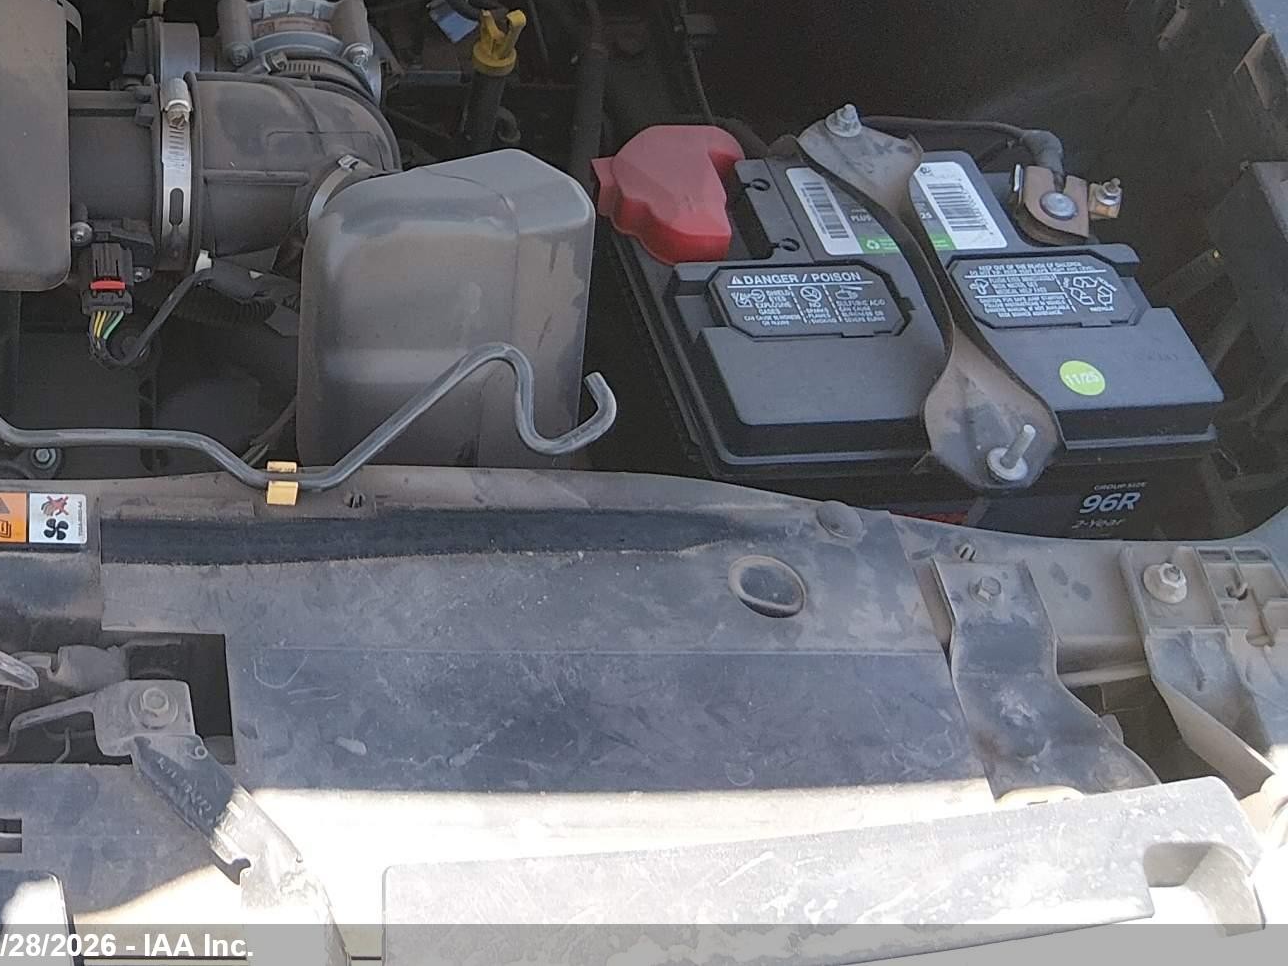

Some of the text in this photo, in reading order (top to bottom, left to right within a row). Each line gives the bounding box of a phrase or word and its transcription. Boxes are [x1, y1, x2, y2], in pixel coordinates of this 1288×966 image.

[743, 271, 861, 285] DANGER / POISON
[1065, 372, 1099, 385] 11/25
[1079, 491, 1141, 514] 96R
